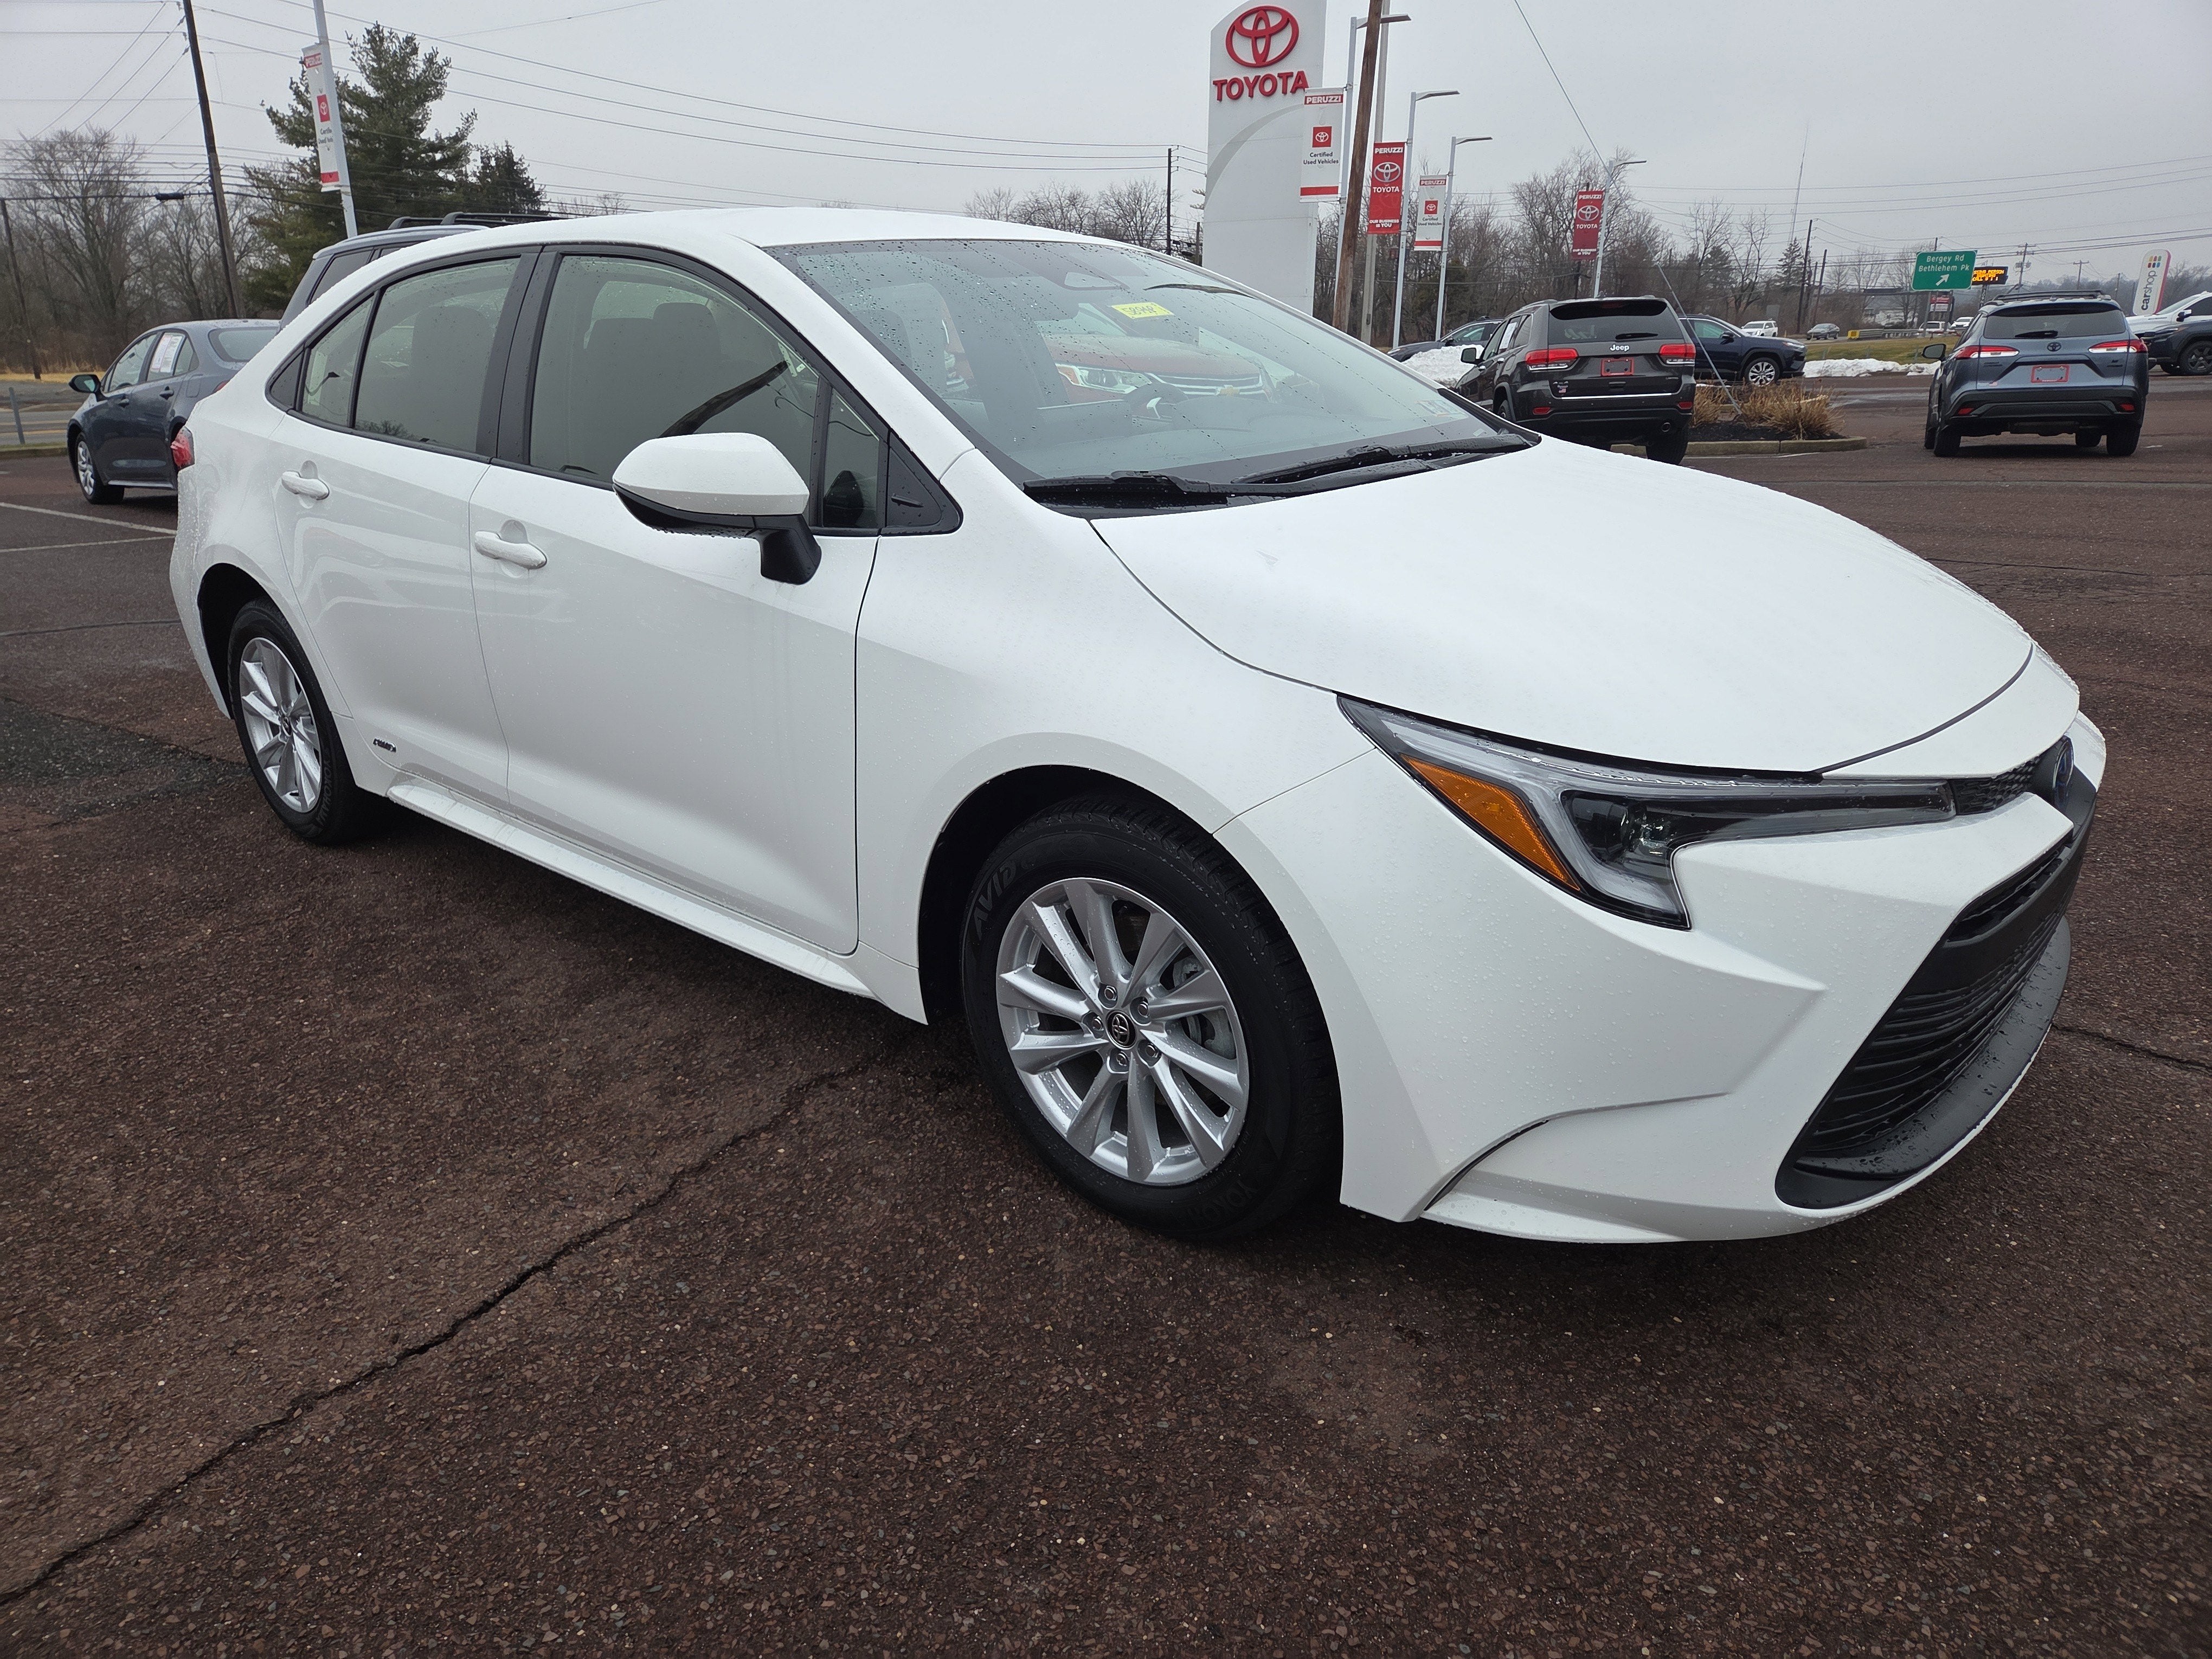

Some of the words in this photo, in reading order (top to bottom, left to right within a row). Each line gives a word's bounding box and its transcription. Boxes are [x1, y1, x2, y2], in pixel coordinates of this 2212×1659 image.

[1212, 70, 1309, 101] TOYOTA
[1307, 95, 1341, 104] PERUZZI
[2141, 270, 2157, 310] carshop
[974, 860, 1016, 941] AVID
